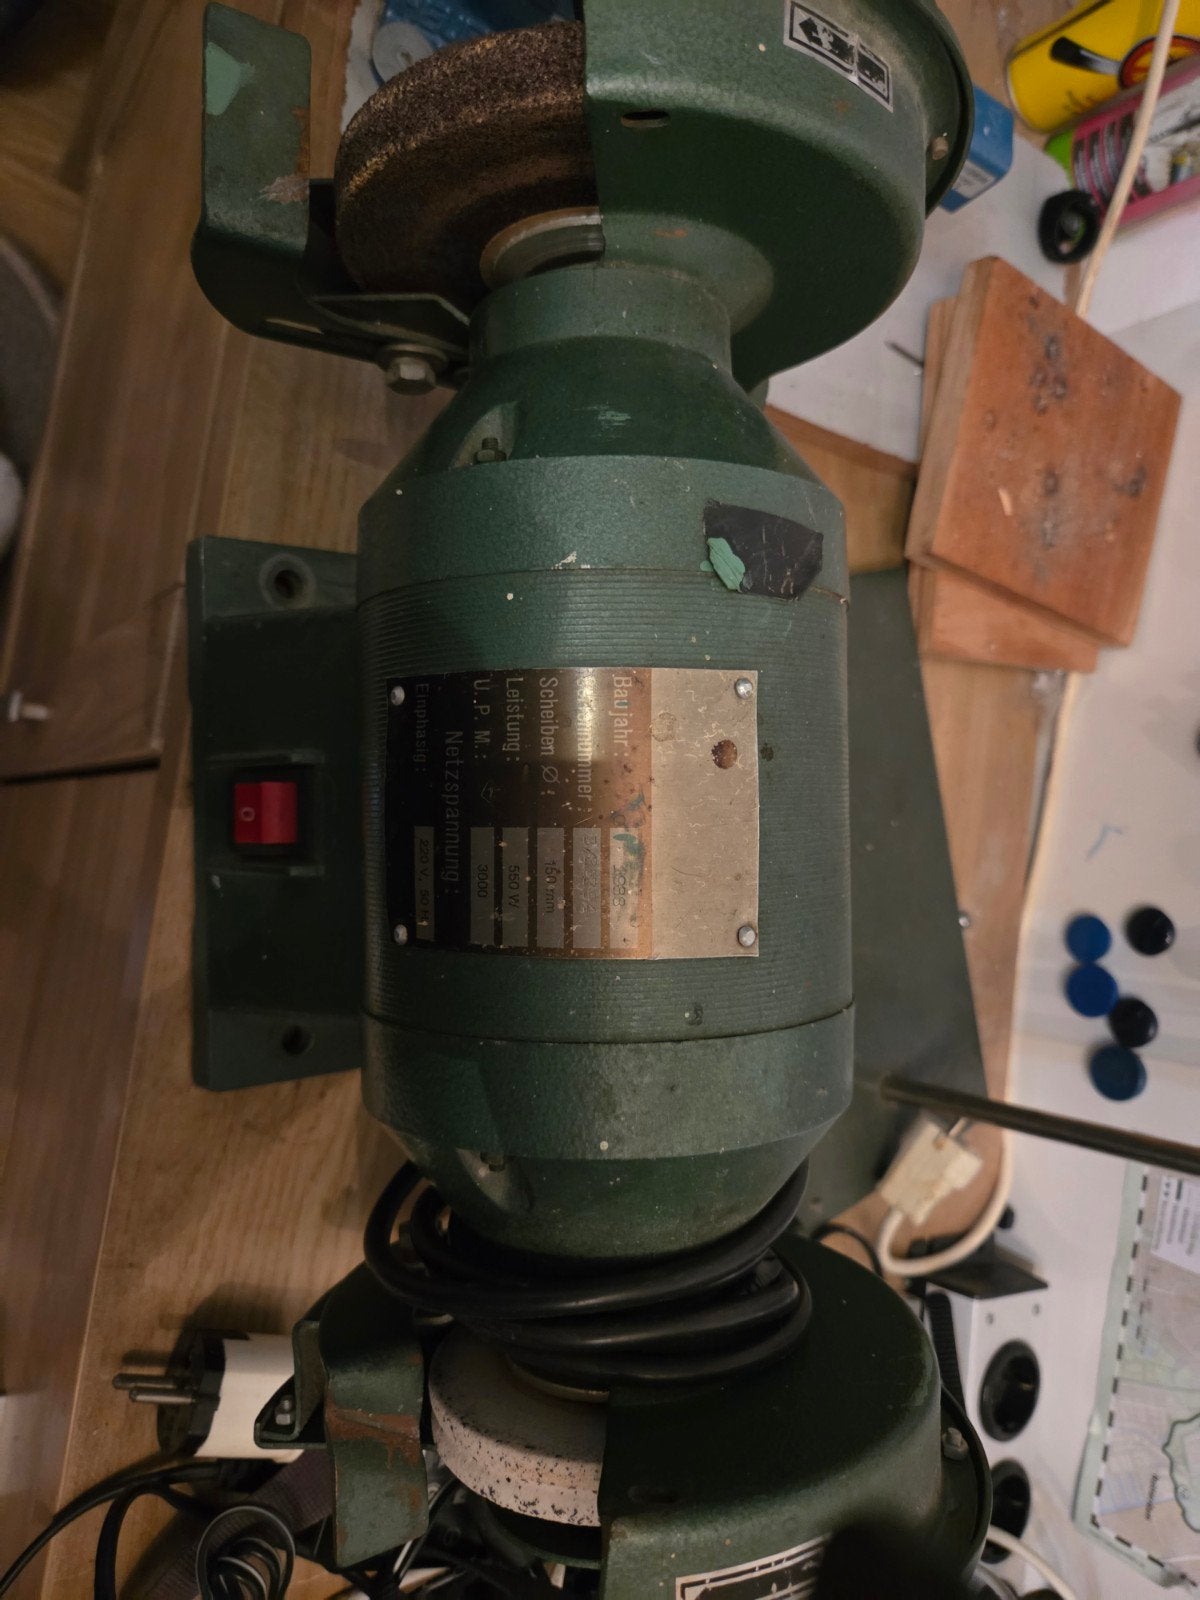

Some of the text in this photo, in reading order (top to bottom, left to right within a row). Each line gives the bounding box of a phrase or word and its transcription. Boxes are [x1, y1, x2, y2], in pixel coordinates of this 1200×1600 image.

[539, 677, 559, 757] Scheiben
[419, 838, 430, 864] 220
[419, 889, 430, 906] 50
[477, 864, 488, 898] 3000
[508, 865, 520, 909] 550 W
[544, 860, 557, 914] 150 mm
